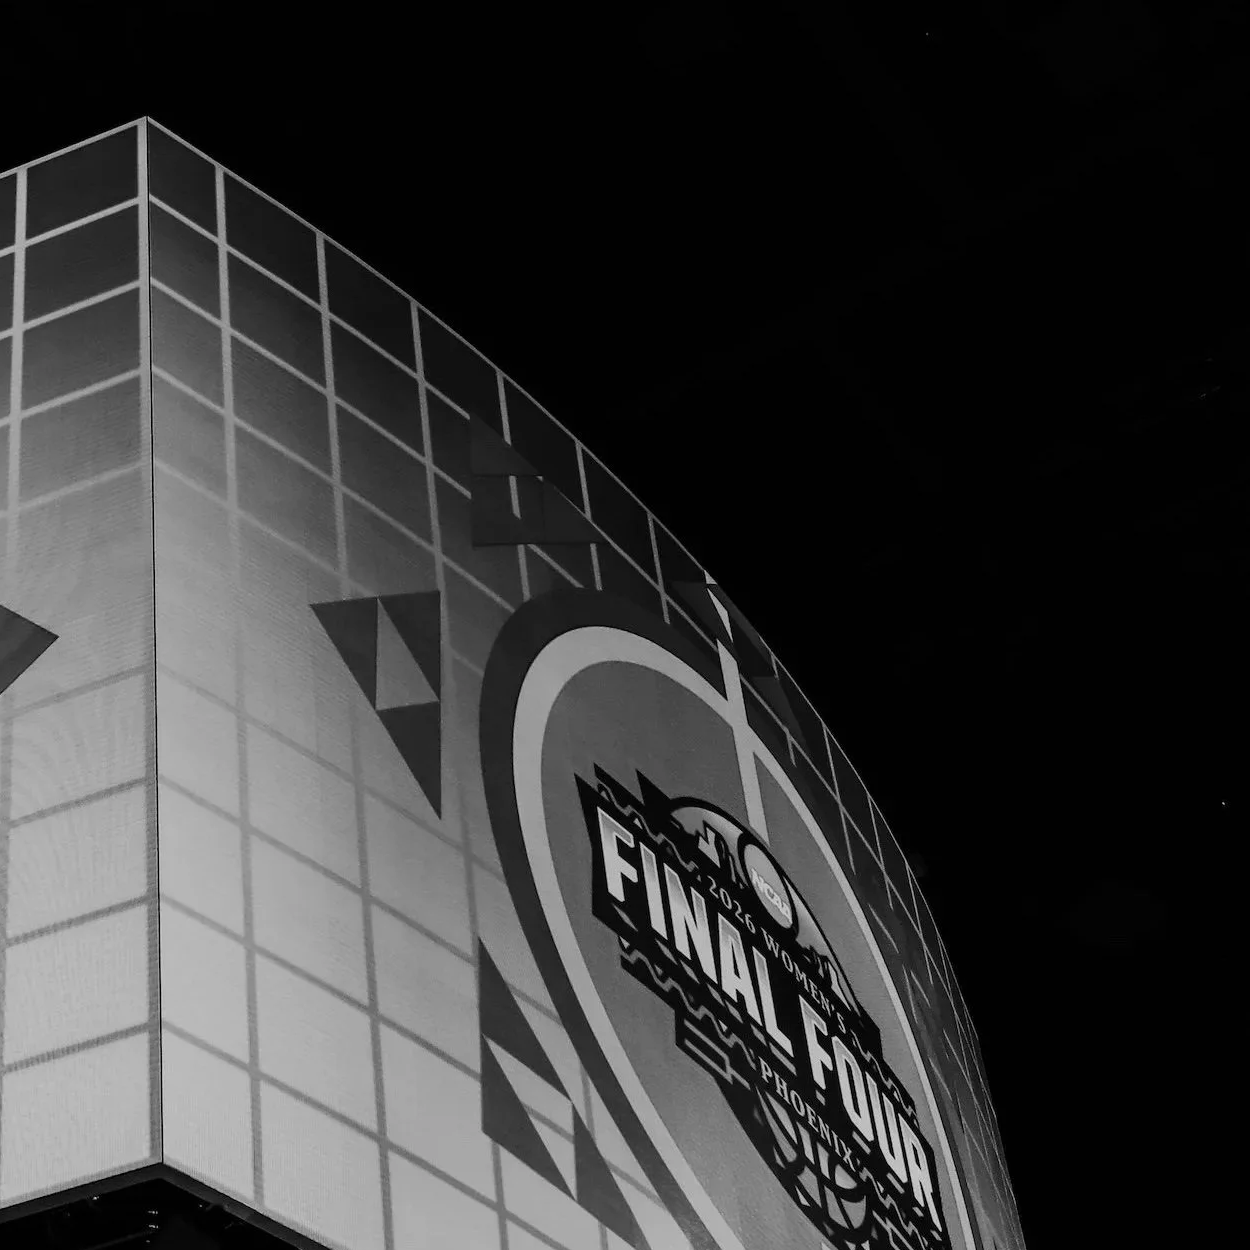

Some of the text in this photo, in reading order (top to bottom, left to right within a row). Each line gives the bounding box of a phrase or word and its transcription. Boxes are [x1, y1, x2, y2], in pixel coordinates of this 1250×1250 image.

[596, 805, 943, 1233] FINAL FOUR
[707, 875, 847, 1035] 2026 WOMEN'S
[758, 1056, 856, 1173] PHOENIX
